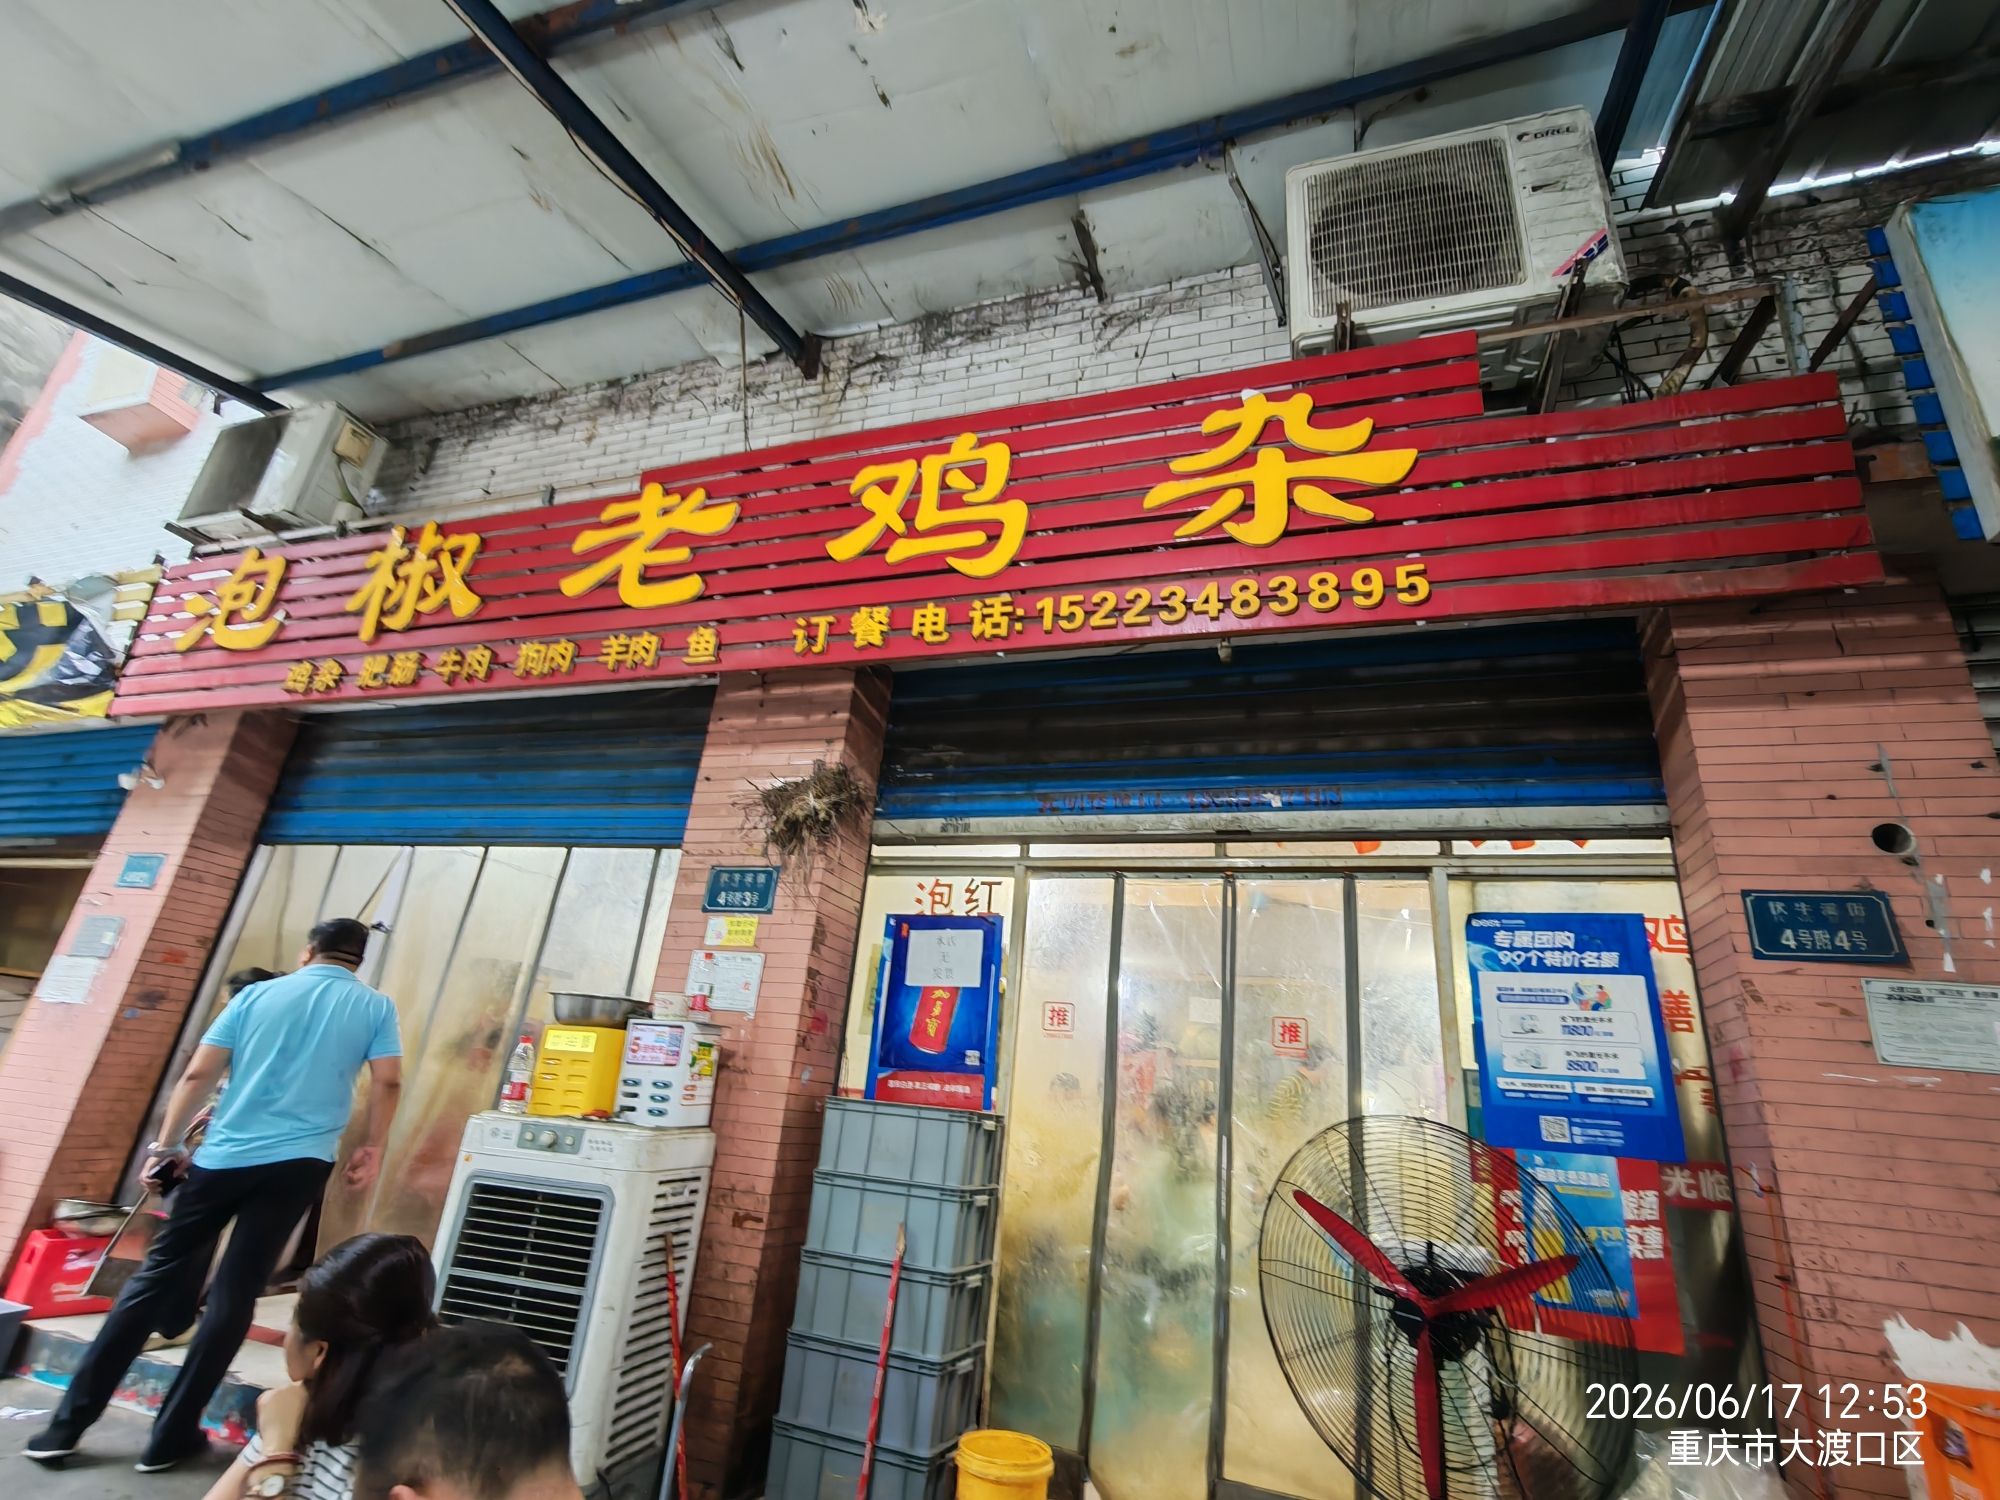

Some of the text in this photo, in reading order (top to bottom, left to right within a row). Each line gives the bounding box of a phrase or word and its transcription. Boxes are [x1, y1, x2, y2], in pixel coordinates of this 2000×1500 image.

[175, 390, 1418, 653] 泡椒老鸡杂
[433, 644, 497, 685] 牛肉
[513, 638, 579, 678] 狗肉
[600, 630, 661, 671] 羊肉
[681, 625, 720, 665] 鱼
[1494, 929, 1575, 949] 专属团购
[1781, 929, 1868, 951] 4号附4号
[1498, 950, 1620, 969] 99个特价名额
[1048, 1006, 1069, 1027] 推
[1280, 1021, 1302, 1044] 推
[1660, 1165, 1732, 1203] 光临
